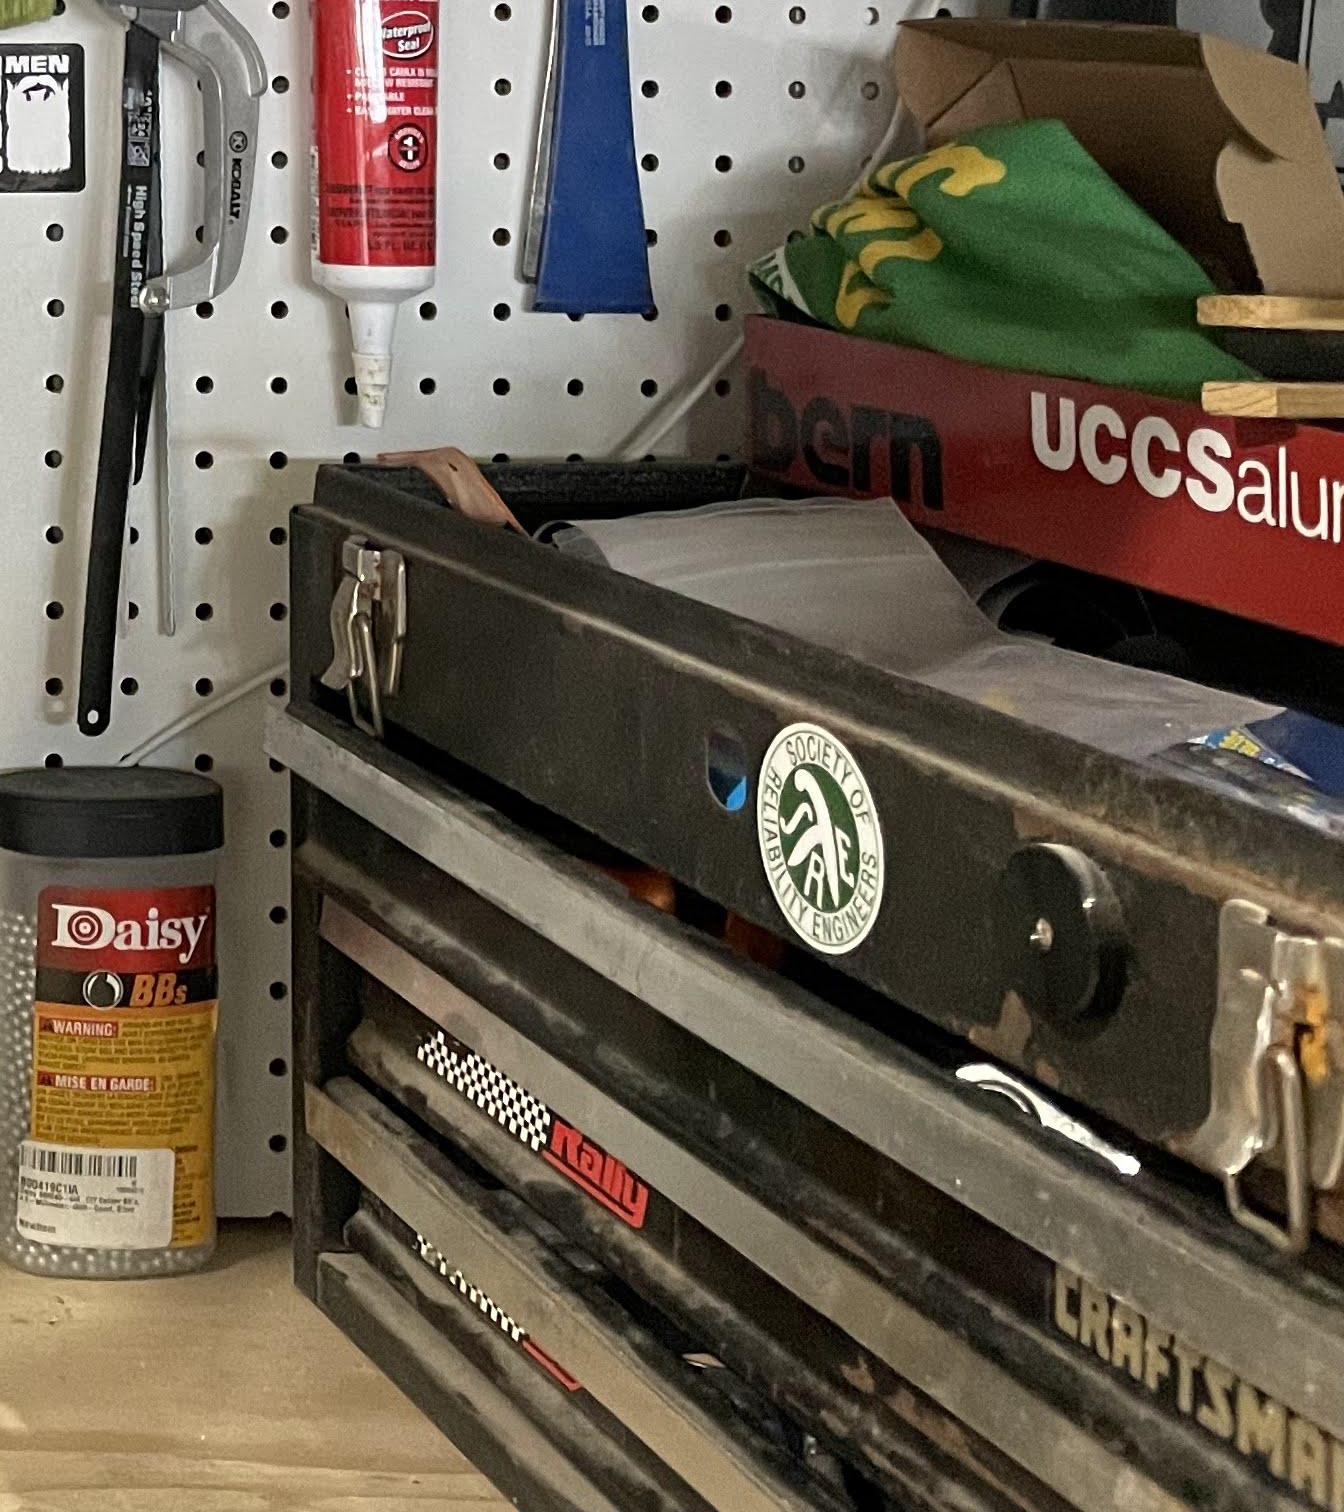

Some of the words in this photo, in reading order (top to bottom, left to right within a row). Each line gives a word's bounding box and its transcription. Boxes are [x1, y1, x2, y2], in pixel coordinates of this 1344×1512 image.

[4, 54, 70, 75] MEN
[397, 37, 420, 53] Seal
[132, 185, 148, 219] High
[229, 157, 242, 220] KOBALT
[130, 221, 145, 269] Speed
[785, 734, 853, 786] SOCIETY
[849, 788, 871, 827] OF
[762, 766, 808, 924] RELIABILITY
[812, 851, 878, 943] ENGINEERS
[50, 903, 209, 965] Daisy
[128, 972, 188, 1008] BBs
[54, 1074, 87, 1089] MISE
[90, 1076, 107, 1090] EN
[543, 1119, 649, 1229] Rally
